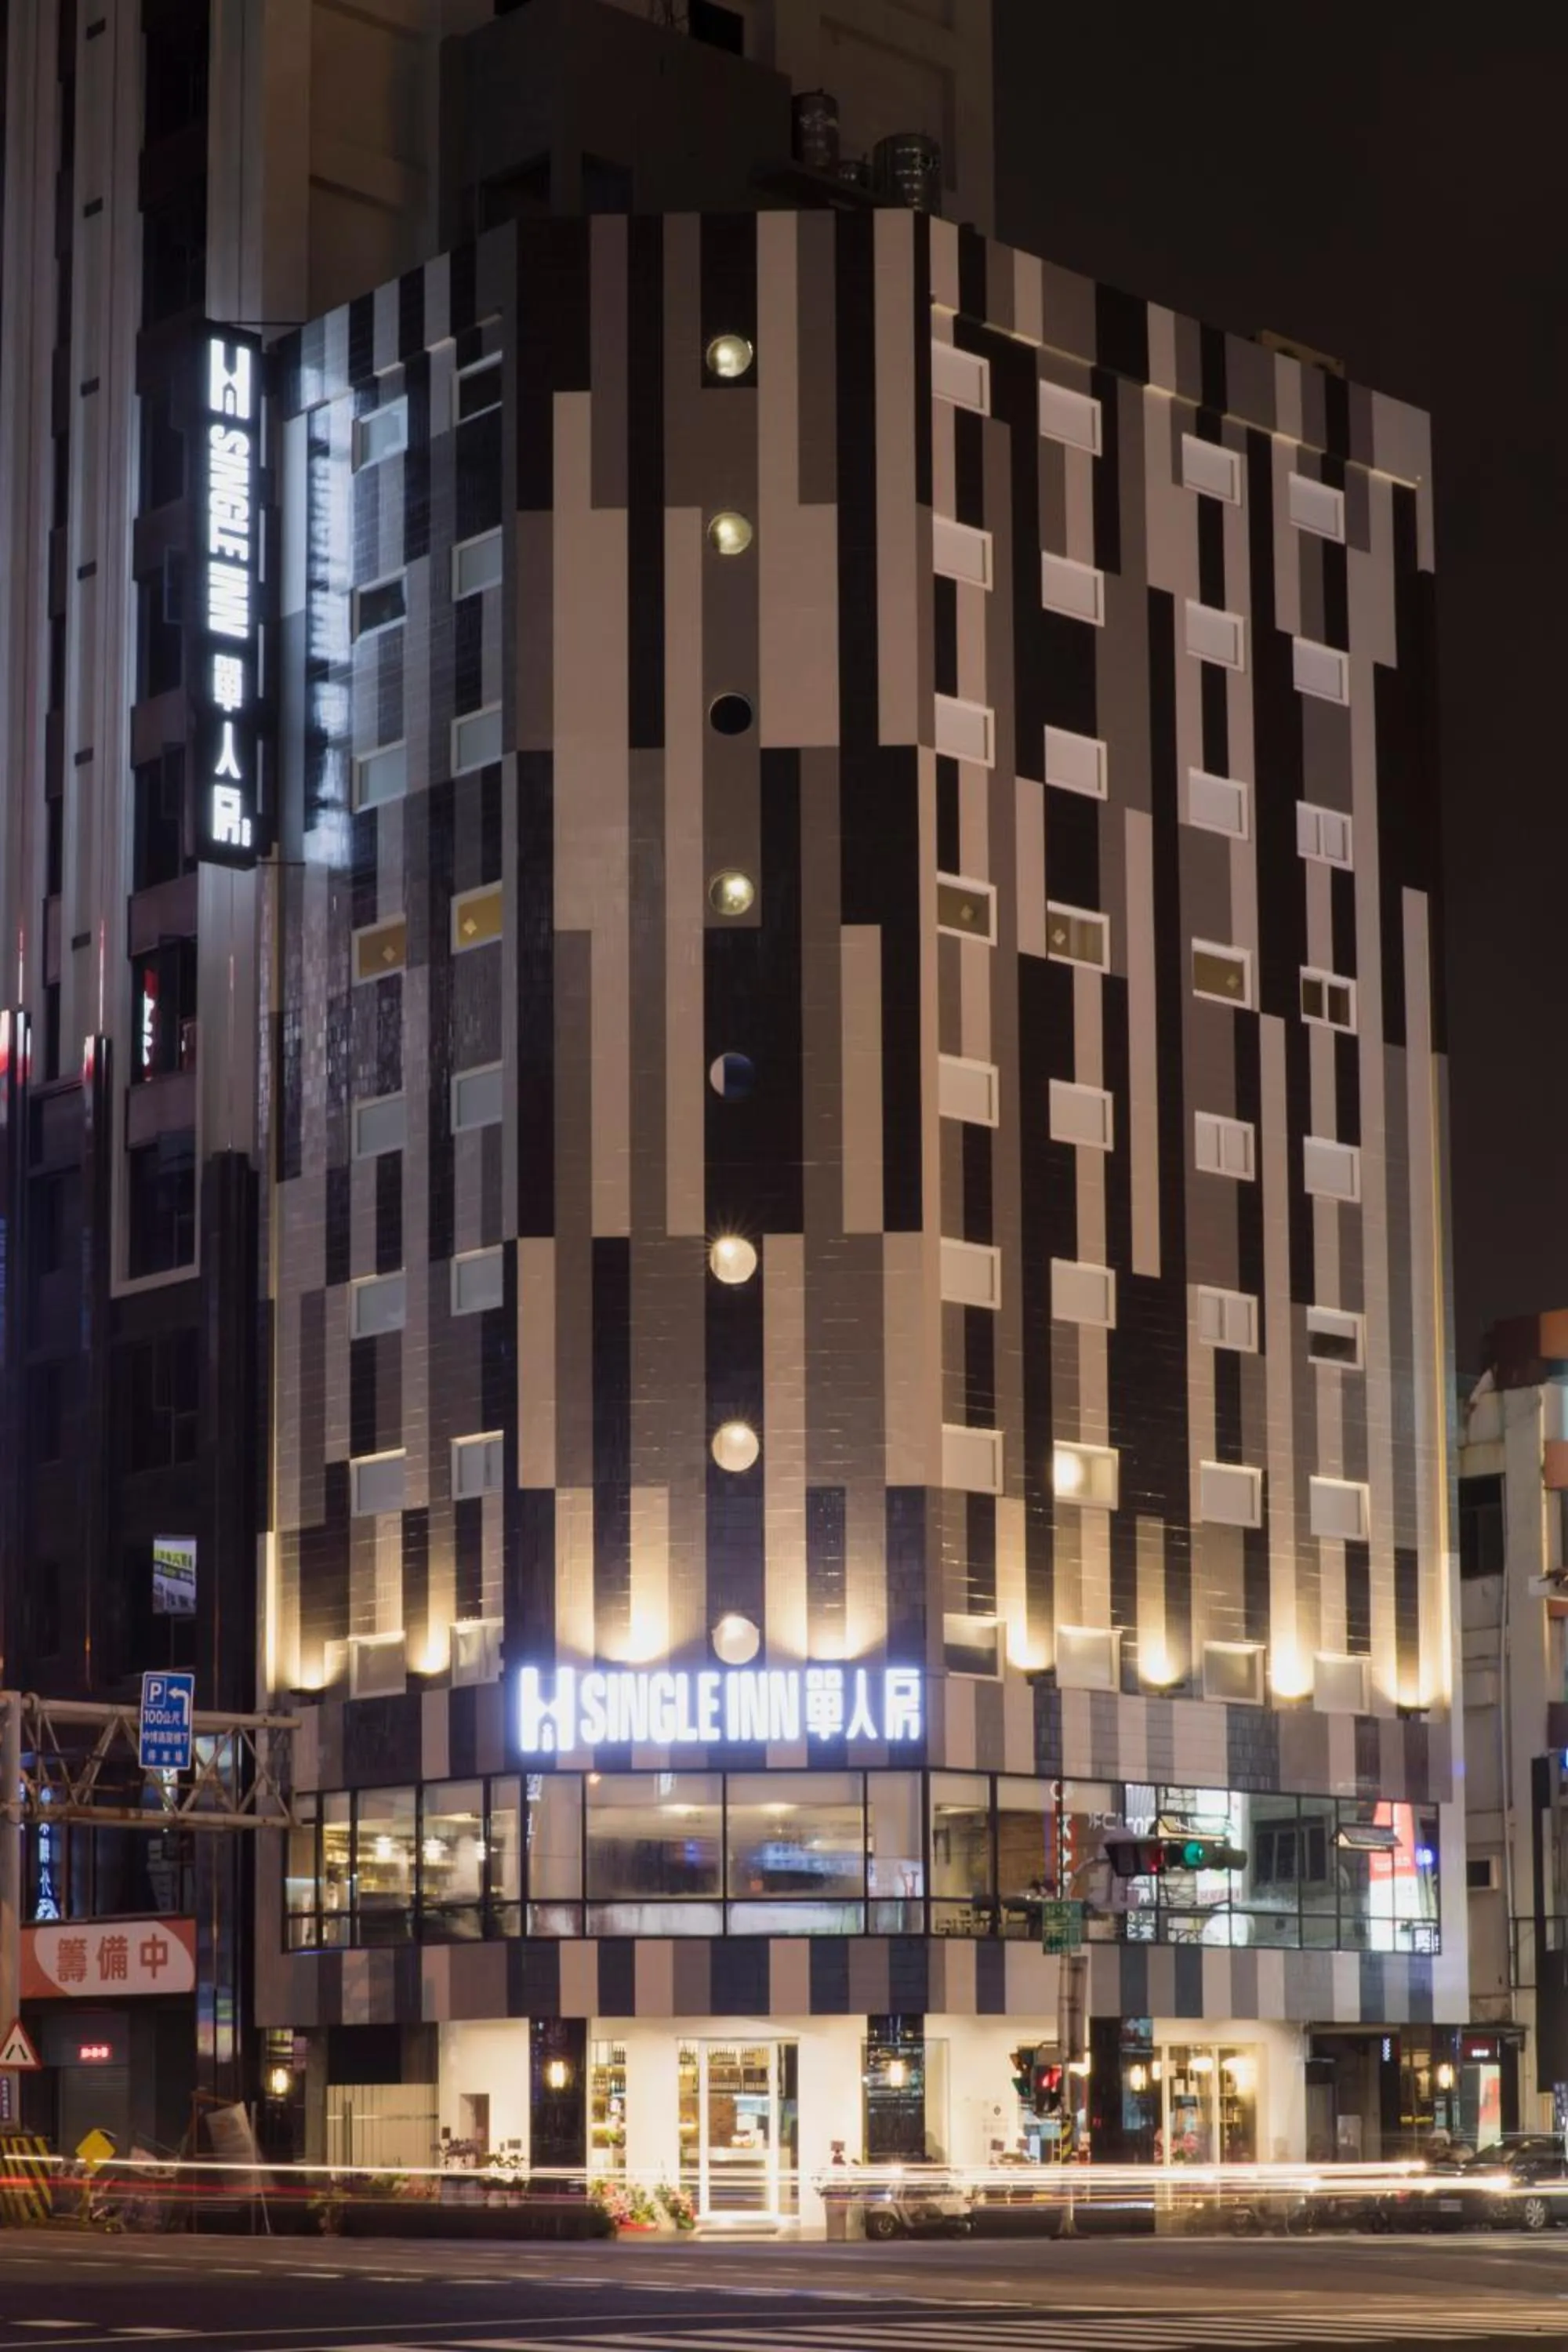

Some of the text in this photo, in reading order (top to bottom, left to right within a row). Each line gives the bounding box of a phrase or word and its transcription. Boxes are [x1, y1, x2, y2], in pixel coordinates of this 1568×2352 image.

[209, 425, 249, 560] SINGLE
[209, 561, 249, 638] INN
[150, 1682, 162, 1702] P
[580, 1672, 720, 1744] SINGLE
[726, 1671, 799, 1740] INN
[806, 1668, 920, 1740] 單人房
[56, 1933, 168, 1982] 籌備中
